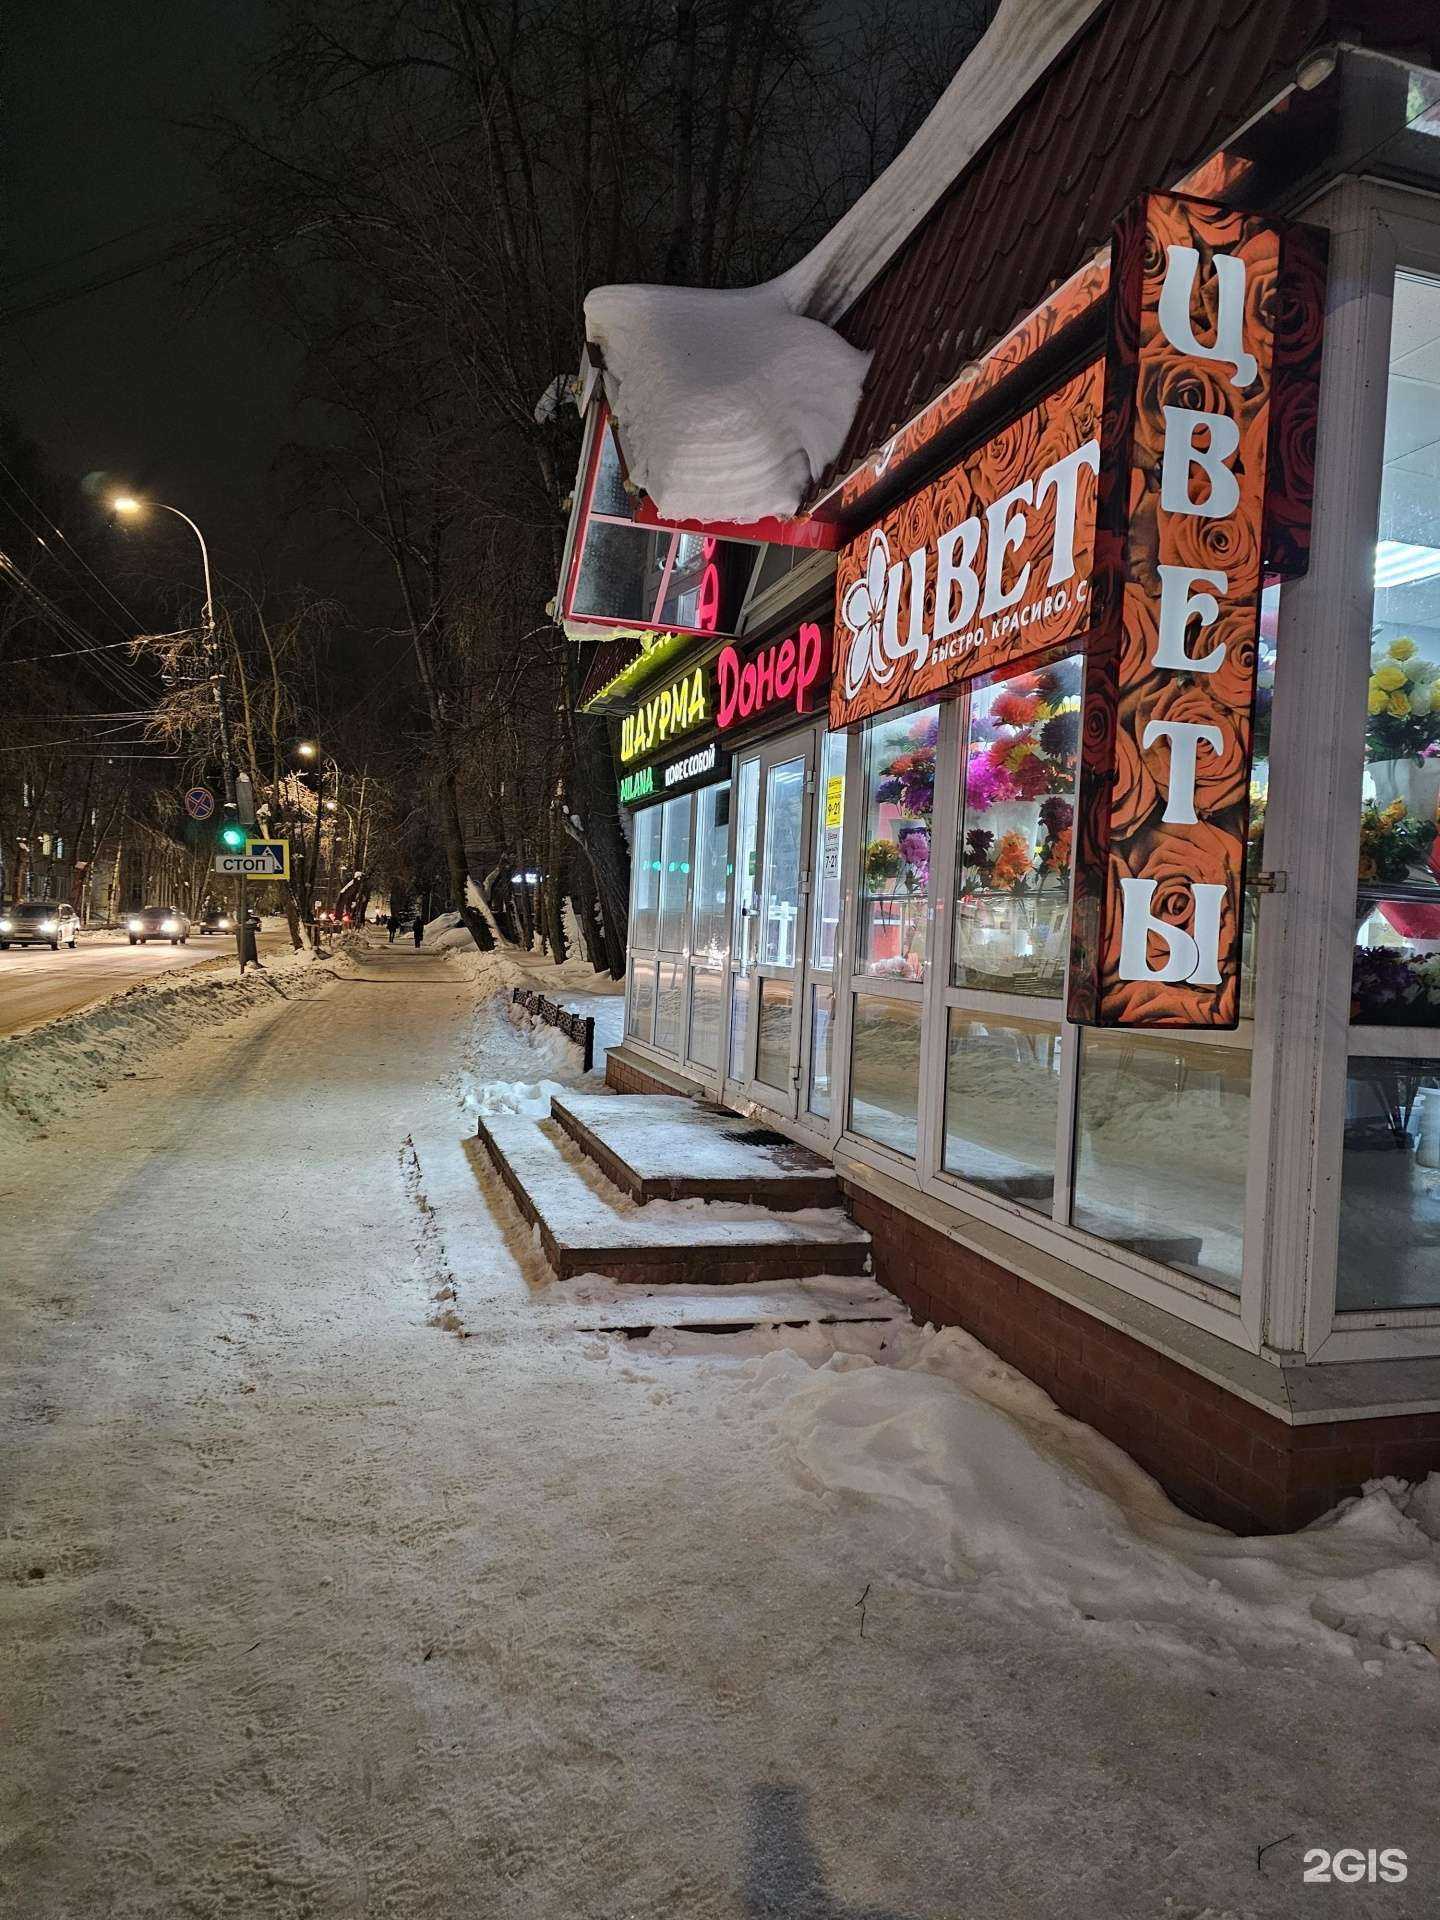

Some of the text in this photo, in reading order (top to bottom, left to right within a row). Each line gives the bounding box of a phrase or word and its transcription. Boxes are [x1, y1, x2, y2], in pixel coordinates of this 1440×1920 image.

[931, 629, 988, 667] БЫСТРО,
[991, 594, 1073, 638] КРАСИВО,
[1119, 244, 1257, 986] ЦВЕТЫ
[620, 667, 706, 762] ШАУРМА
[716, 622, 822, 728] Донер
[223, 858, 266, 871] СТОП
